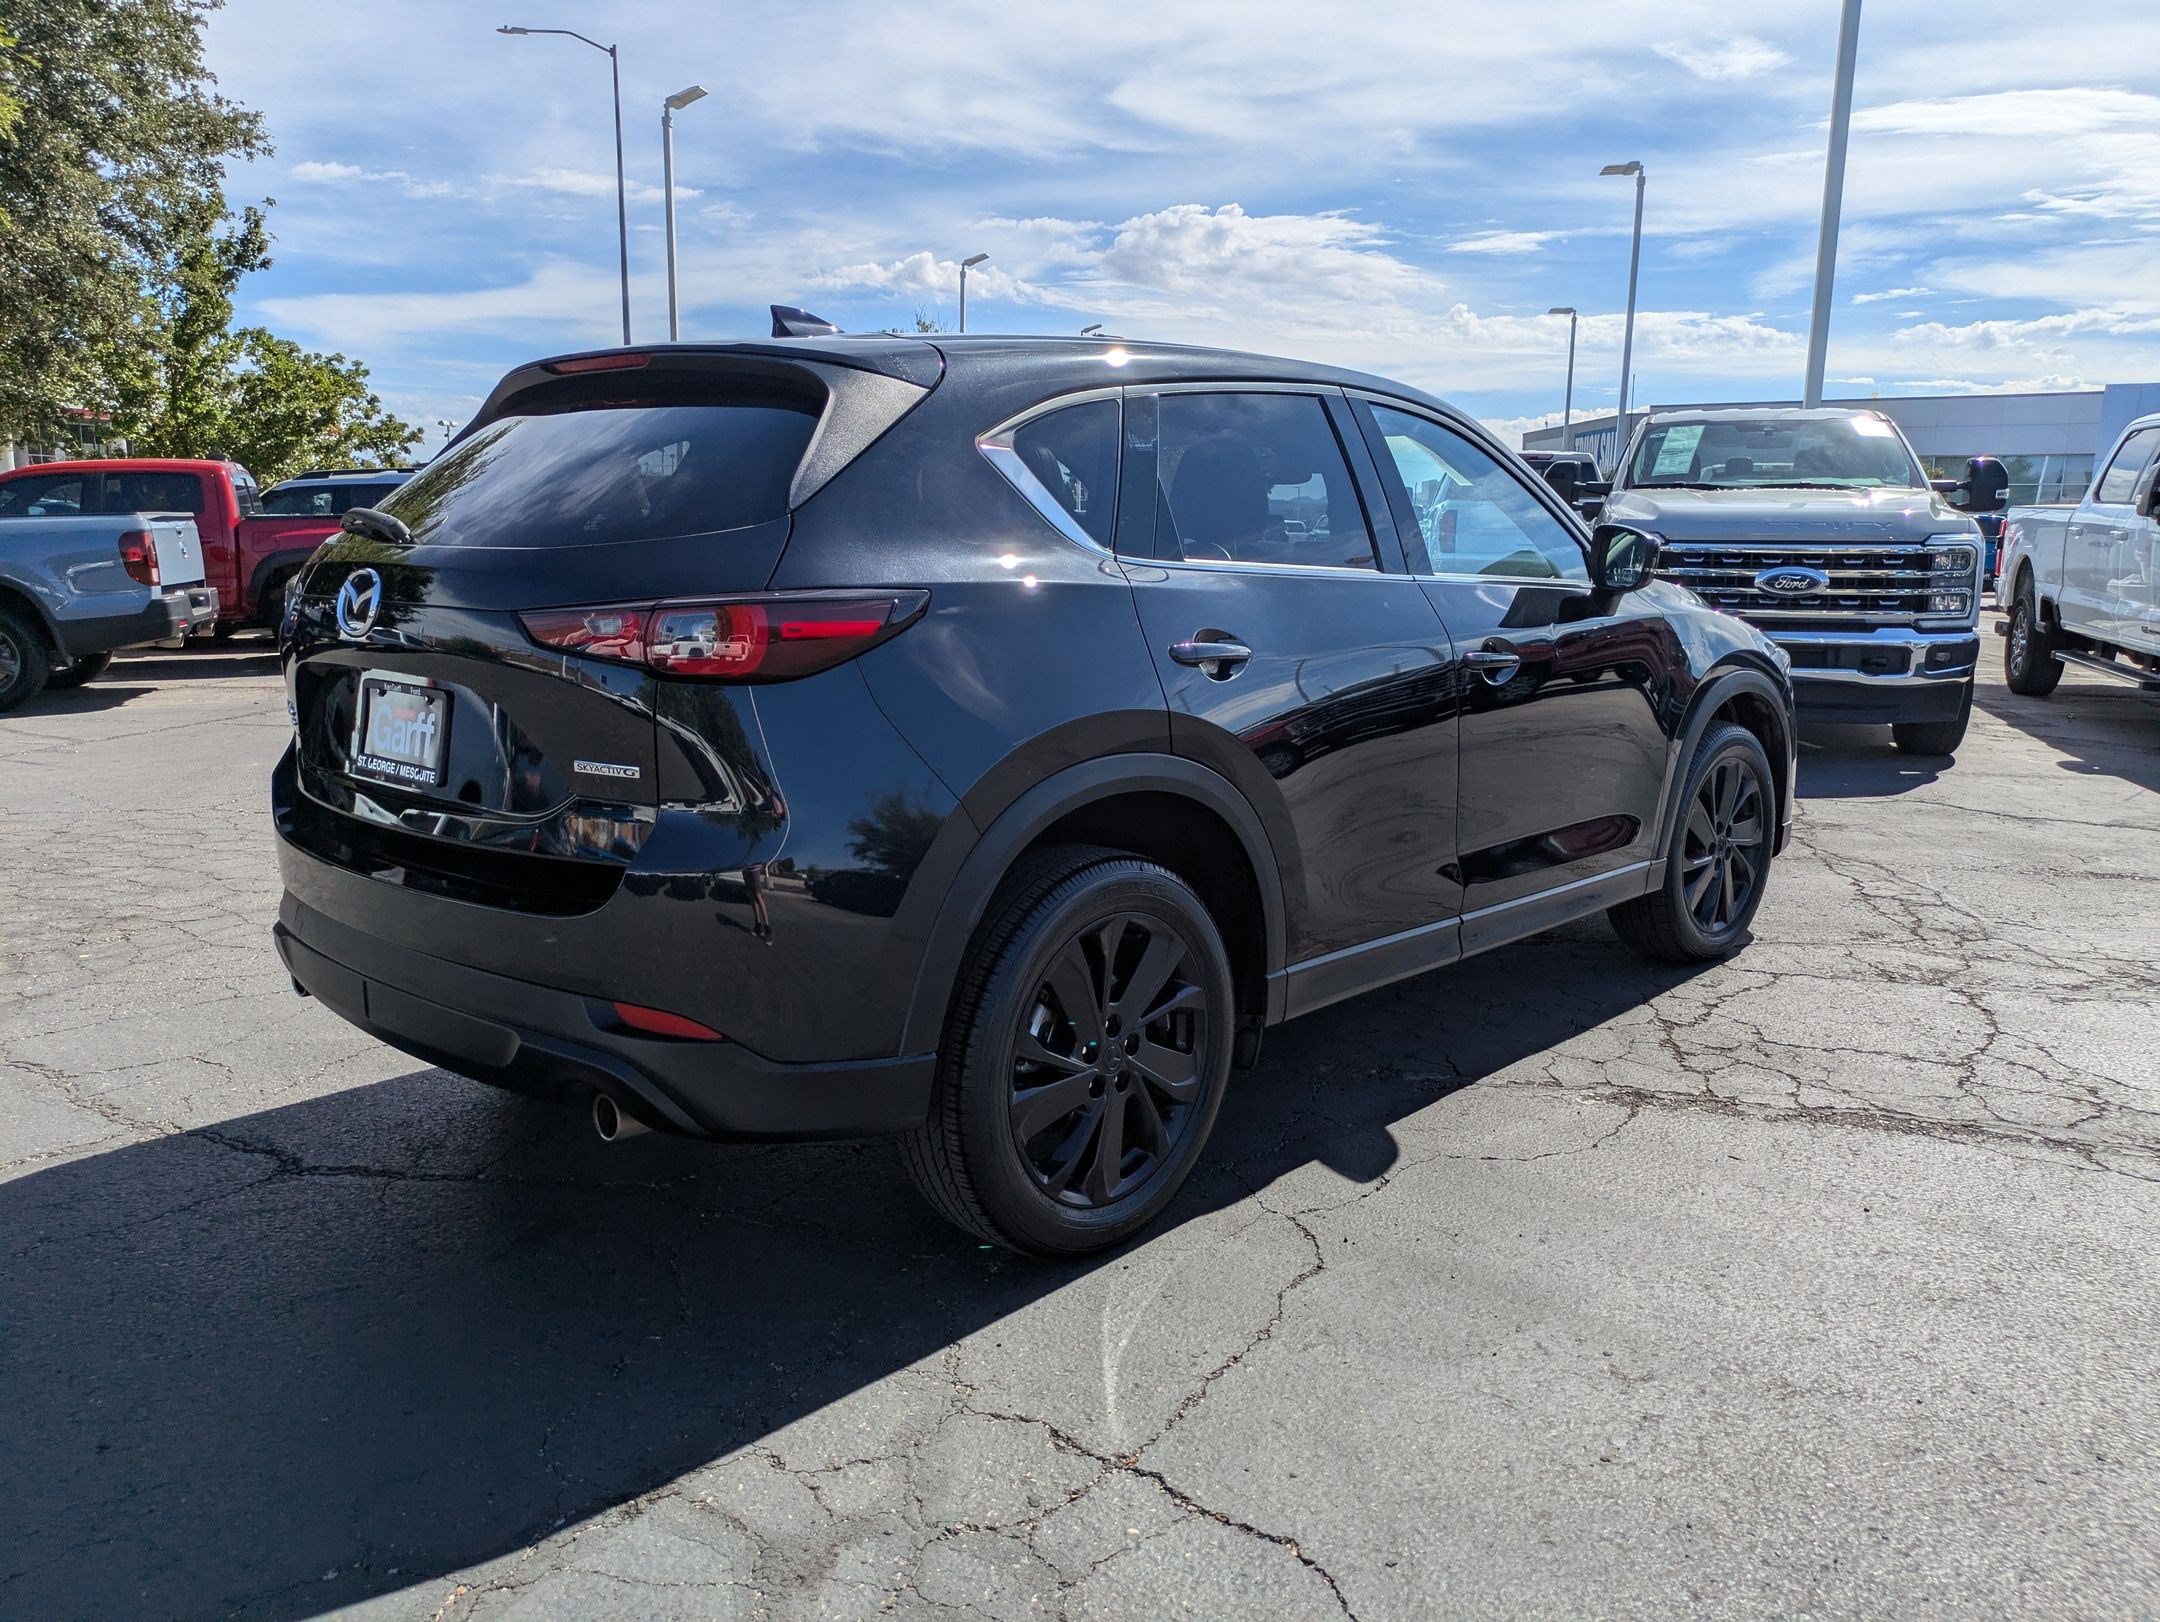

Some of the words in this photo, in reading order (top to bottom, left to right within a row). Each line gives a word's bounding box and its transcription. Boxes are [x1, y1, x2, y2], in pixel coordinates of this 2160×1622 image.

[1600, 432, 1617, 473] SAL
[1774, 574, 1810, 589] Ford
[373, 704, 436, 759] Garff
[357, 755, 367, 768] ST.
[367, 757, 396, 775] GEORGE
